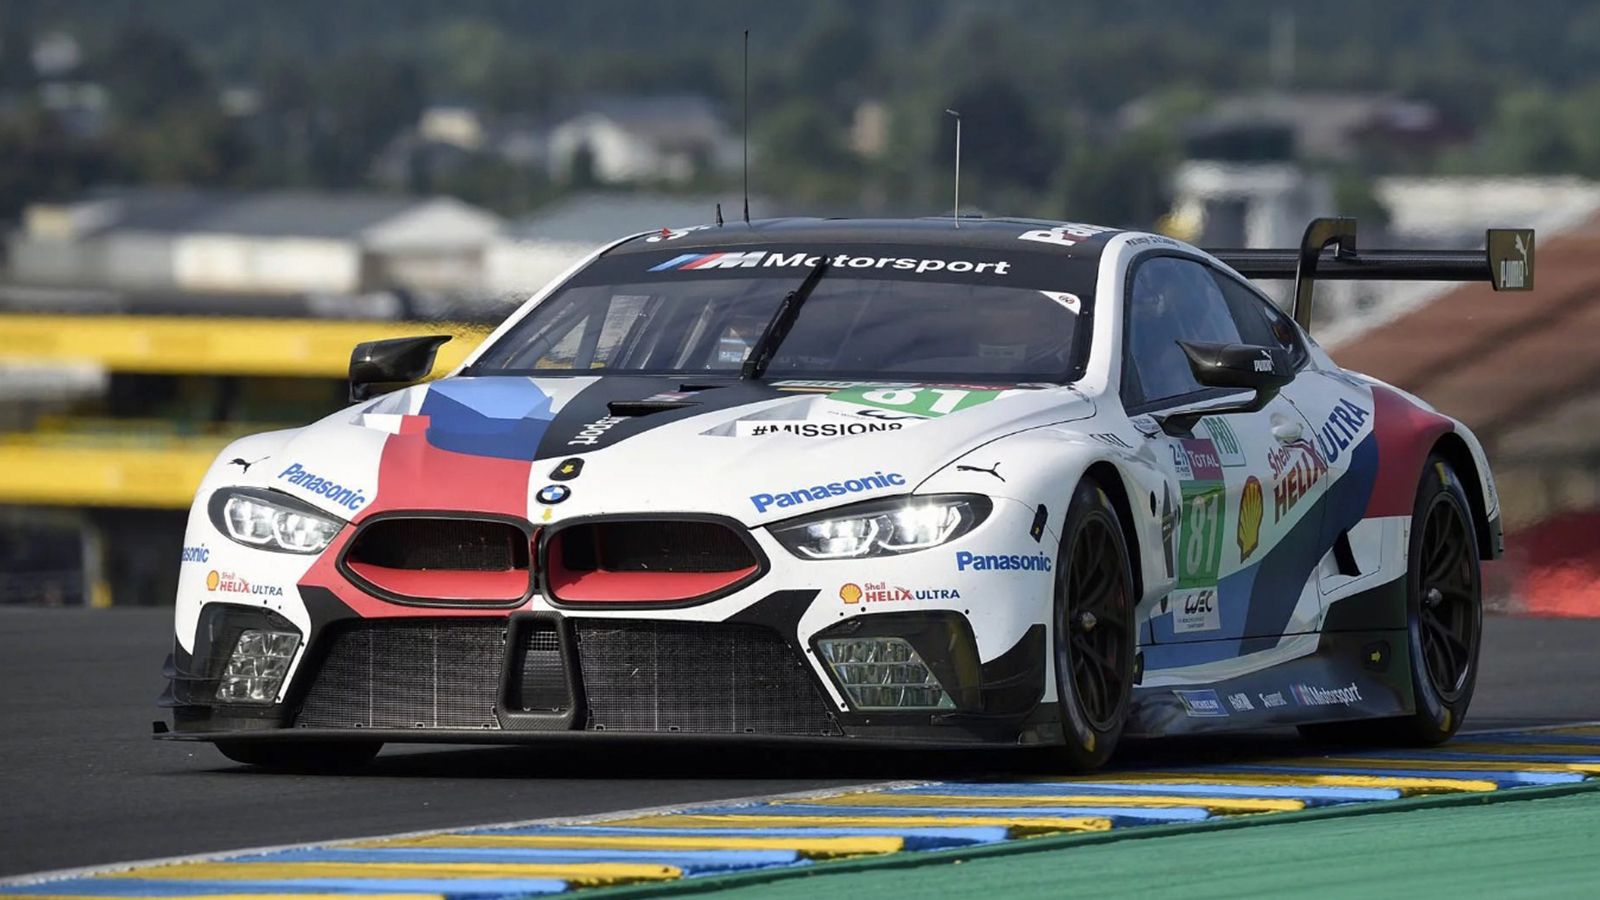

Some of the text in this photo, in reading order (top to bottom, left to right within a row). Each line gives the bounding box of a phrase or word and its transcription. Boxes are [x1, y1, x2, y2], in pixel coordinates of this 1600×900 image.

[763, 252, 1011, 275] Motorsport
[567, 414, 632, 445] sport
[1202, 416, 1239, 455] PRO
[1187, 450, 1220, 468] TOTAL
[1273, 398, 1369, 525] HELIX ULTRA
[278, 463, 365, 510] Panasonic
[750, 470, 906, 513] Panasonic
[1186, 494, 1219, 576] 81
[956, 551, 1051, 572] Panasonic
[220, 578, 283, 596] HELIX ULTRA
[221, 572, 235, 580] Shell
[864, 582, 886, 591] Shell
[865, 587, 960, 602] HELIX ULTRA
[1185, 590, 1214, 614] WEC
